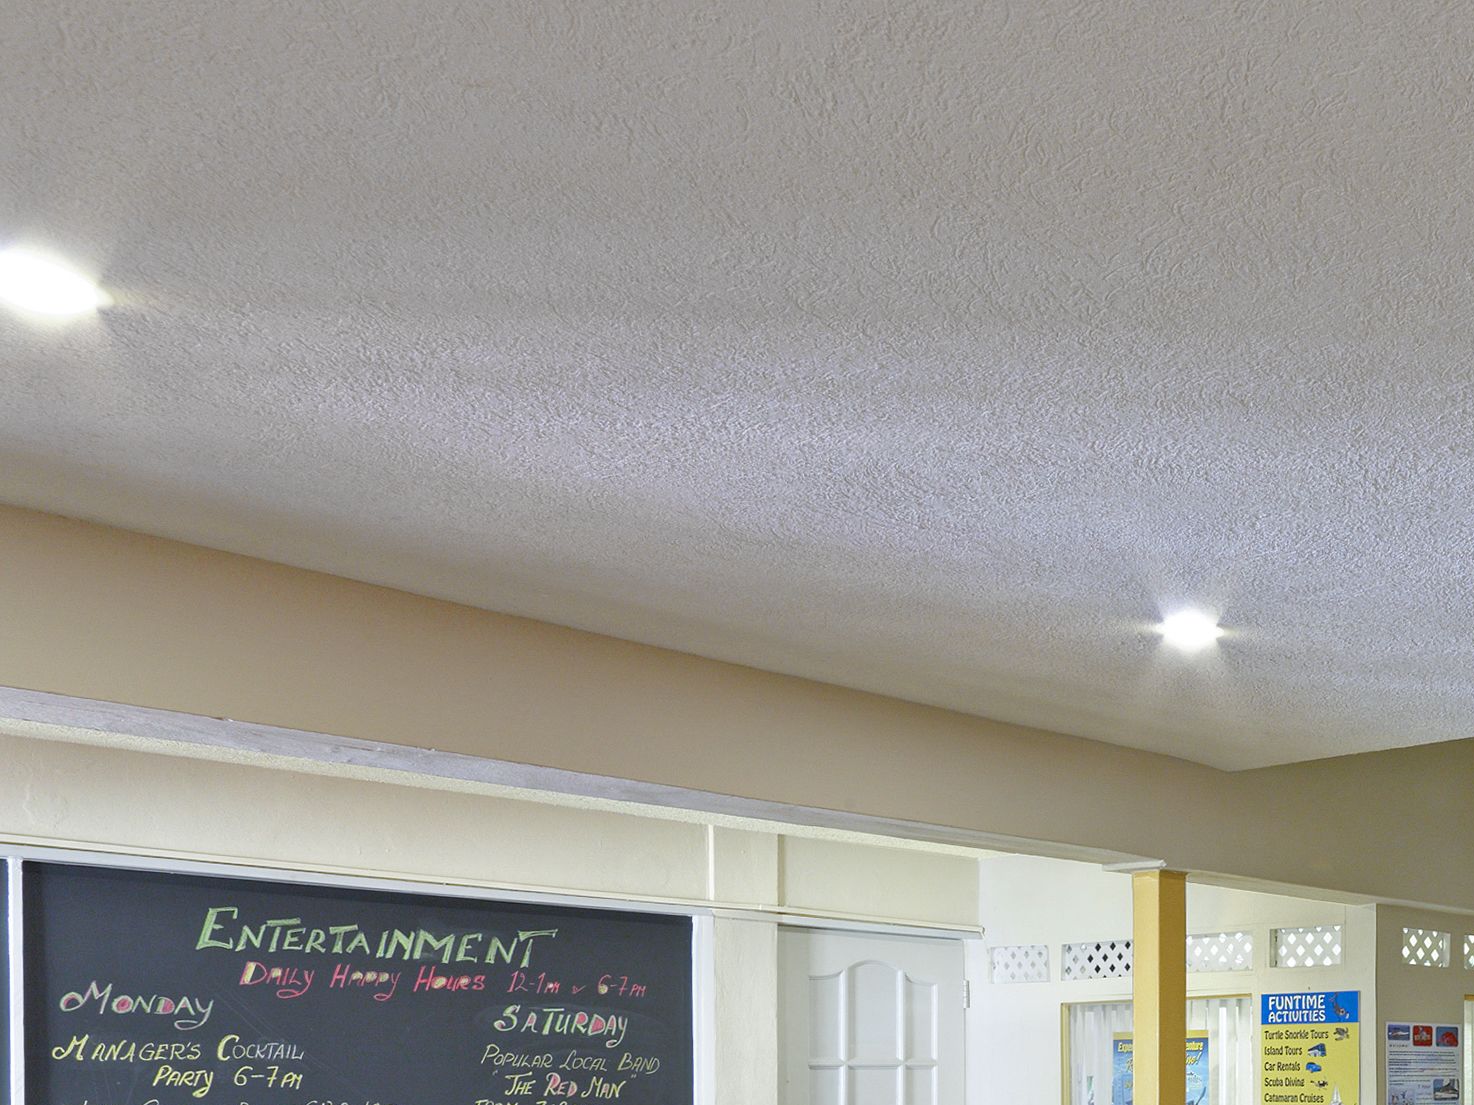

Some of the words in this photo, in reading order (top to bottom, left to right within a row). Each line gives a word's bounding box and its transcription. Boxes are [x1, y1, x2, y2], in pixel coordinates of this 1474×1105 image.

[196, 907, 558, 967] ENTERTAINMENT
[413, 966, 486, 992] HOURS
[60, 980, 214, 1030] MONDAY
[1268, 995, 1326, 1011] FUNTIME
[494, 1005, 627, 1048] SATURDAY
[1268, 1010, 1326, 1023] ACTIVITIES
[1264, 1030, 1283, 1040] Turtle
[1284, 1029, 1309, 1040] Snorkle
[1310, 1029, 1329, 1039] Tours
[217, 1034, 305, 1061] COCKTAIL
[480, 1043, 554, 1068] POPULAR
[560, 1050, 607, 1071] LOCAL
[617, 1052, 661, 1074] BAND
[1264, 1046, 1283, 1055] Island
[1284, 1046, 1303, 1055] Tours
[1264, 1062, 1276, 1071] Car
[1277, 1061, 1300, 1071] Rentals
[152, 1065, 214, 1097] PARTY
[544, 1073, 578, 1097] RED
[1264, 1077, 1283, 1087] Scuba
[1285, 1077, 1305, 1087] Diving
[1264, 1093, 1298, 1102] Catamaran
[1299, 1093, 1324, 1103] Cruises
